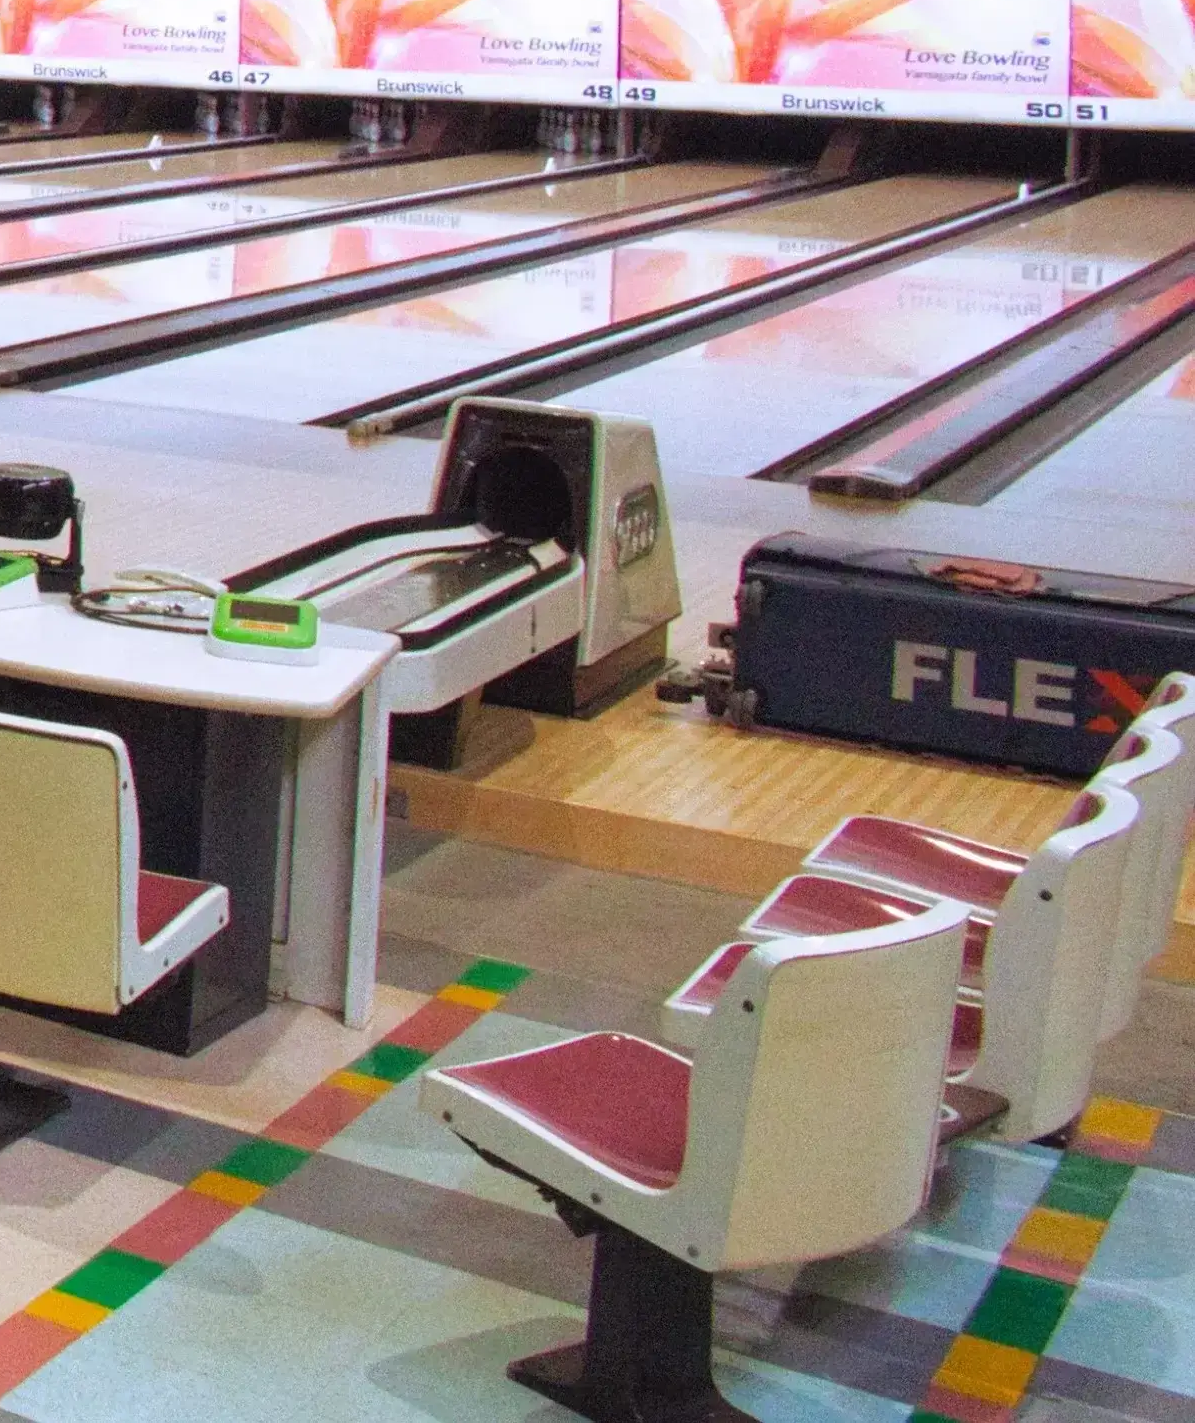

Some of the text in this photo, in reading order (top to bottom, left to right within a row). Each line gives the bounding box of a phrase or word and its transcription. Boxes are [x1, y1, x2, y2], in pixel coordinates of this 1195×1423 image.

[122, 24, 226, 44] Love Bowling
[480, 36, 602, 57] Love Bowling
[904, 48, 1051, 71] Love Bowling
[32, 63, 108, 80] Brunswick
[208, 71, 234, 84] 46
[904, 68, 1048, 84] Yamagata family bowl
[243, 71, 613, 100] 47 Brunswick 48
[624, 87, 1063, 120] 49 Brunswick 50
[1076, 104, 1109, 121] 51
